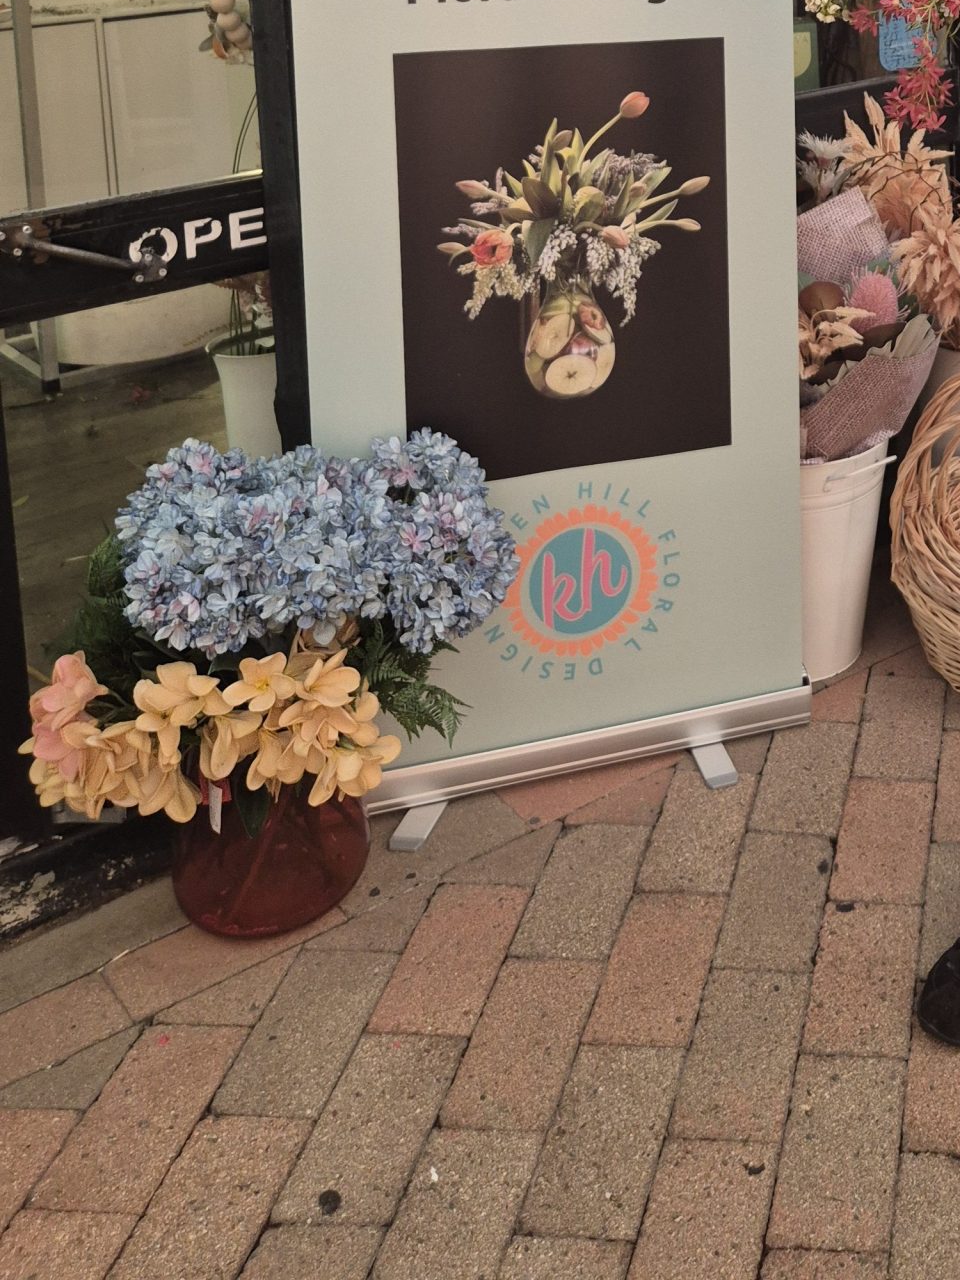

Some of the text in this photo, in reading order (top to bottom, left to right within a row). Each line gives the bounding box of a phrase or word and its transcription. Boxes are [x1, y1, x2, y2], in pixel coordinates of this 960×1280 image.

[484, 481, 681, 681] HILL FLORAL DESIGN
